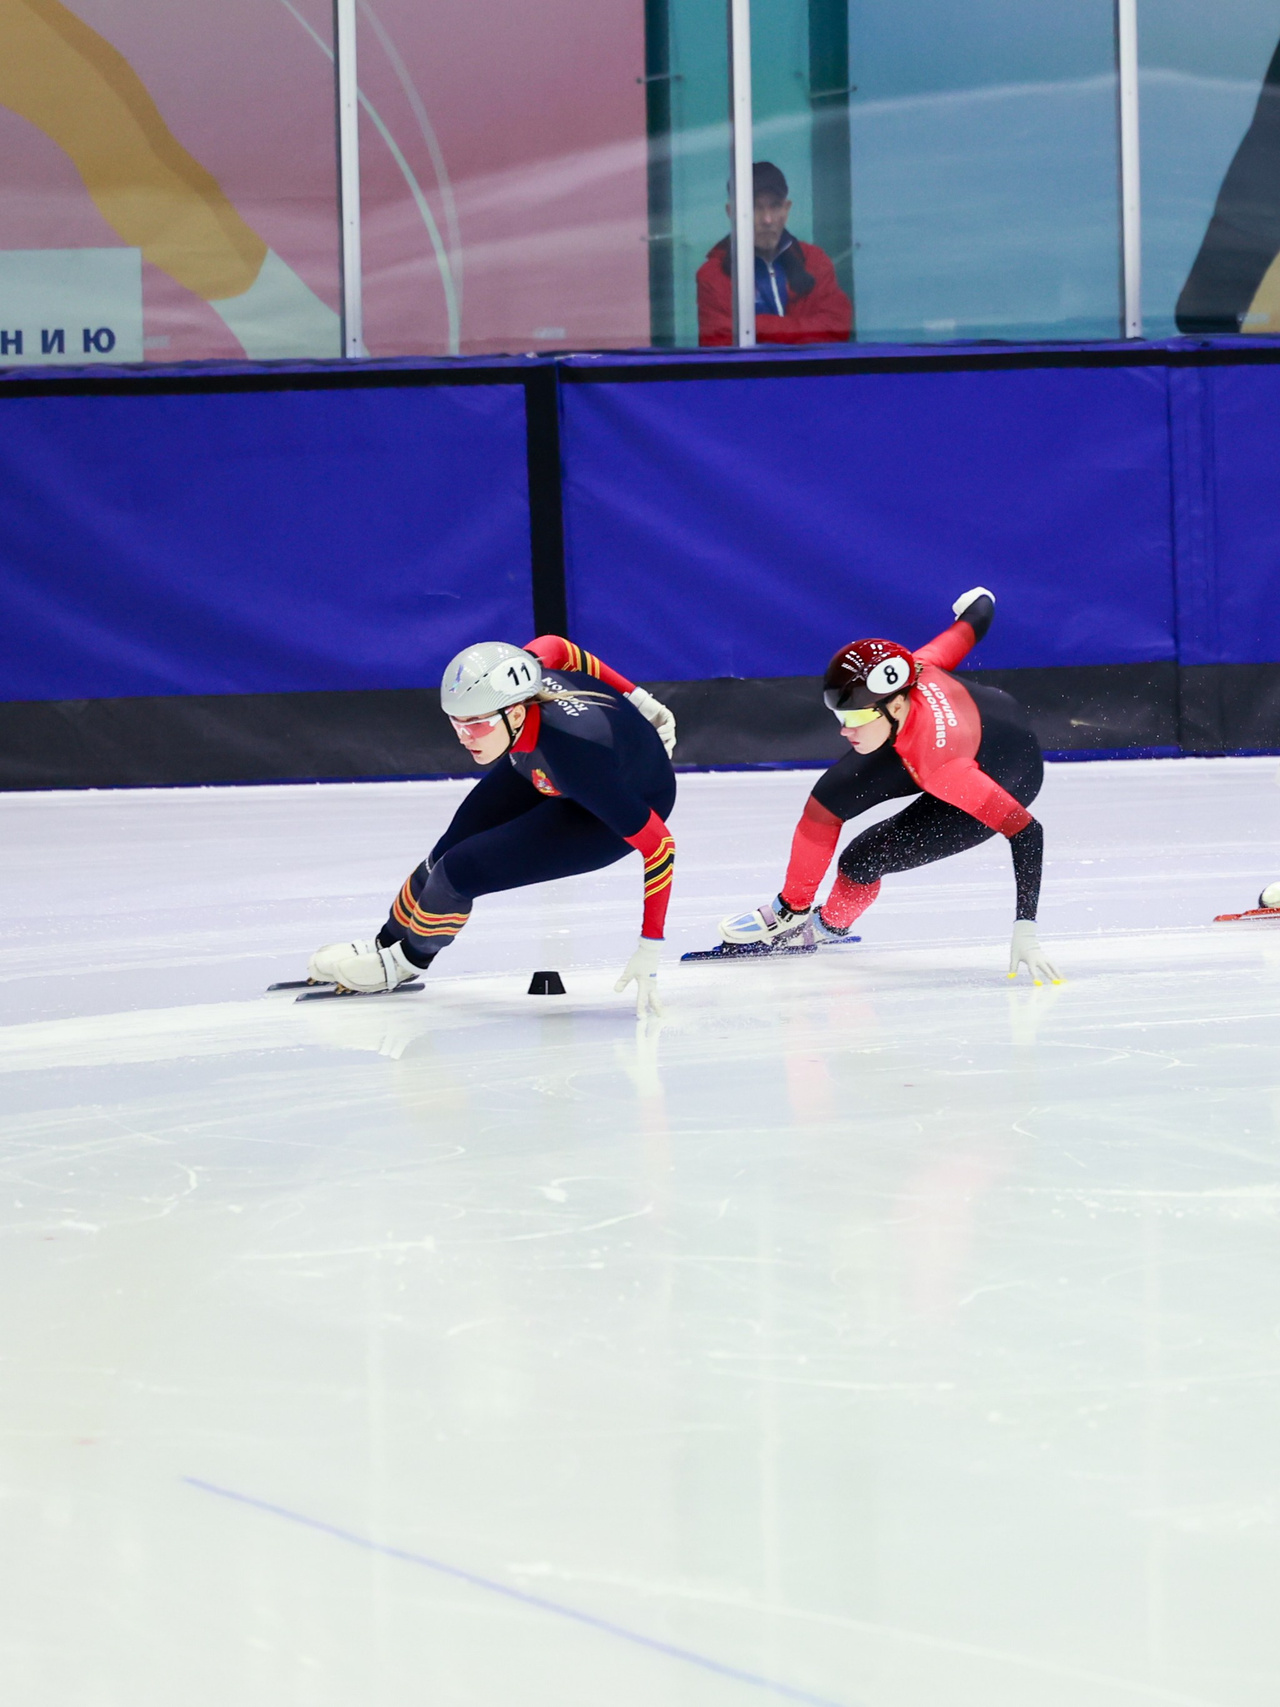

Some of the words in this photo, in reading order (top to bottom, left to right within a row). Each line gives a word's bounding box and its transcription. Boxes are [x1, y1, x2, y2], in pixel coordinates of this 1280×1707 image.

[507, 662, 531, 686] 11
[883, 665, 899, 685] 8
[916, 682, 947, 748] СВЕРДЛОВС
